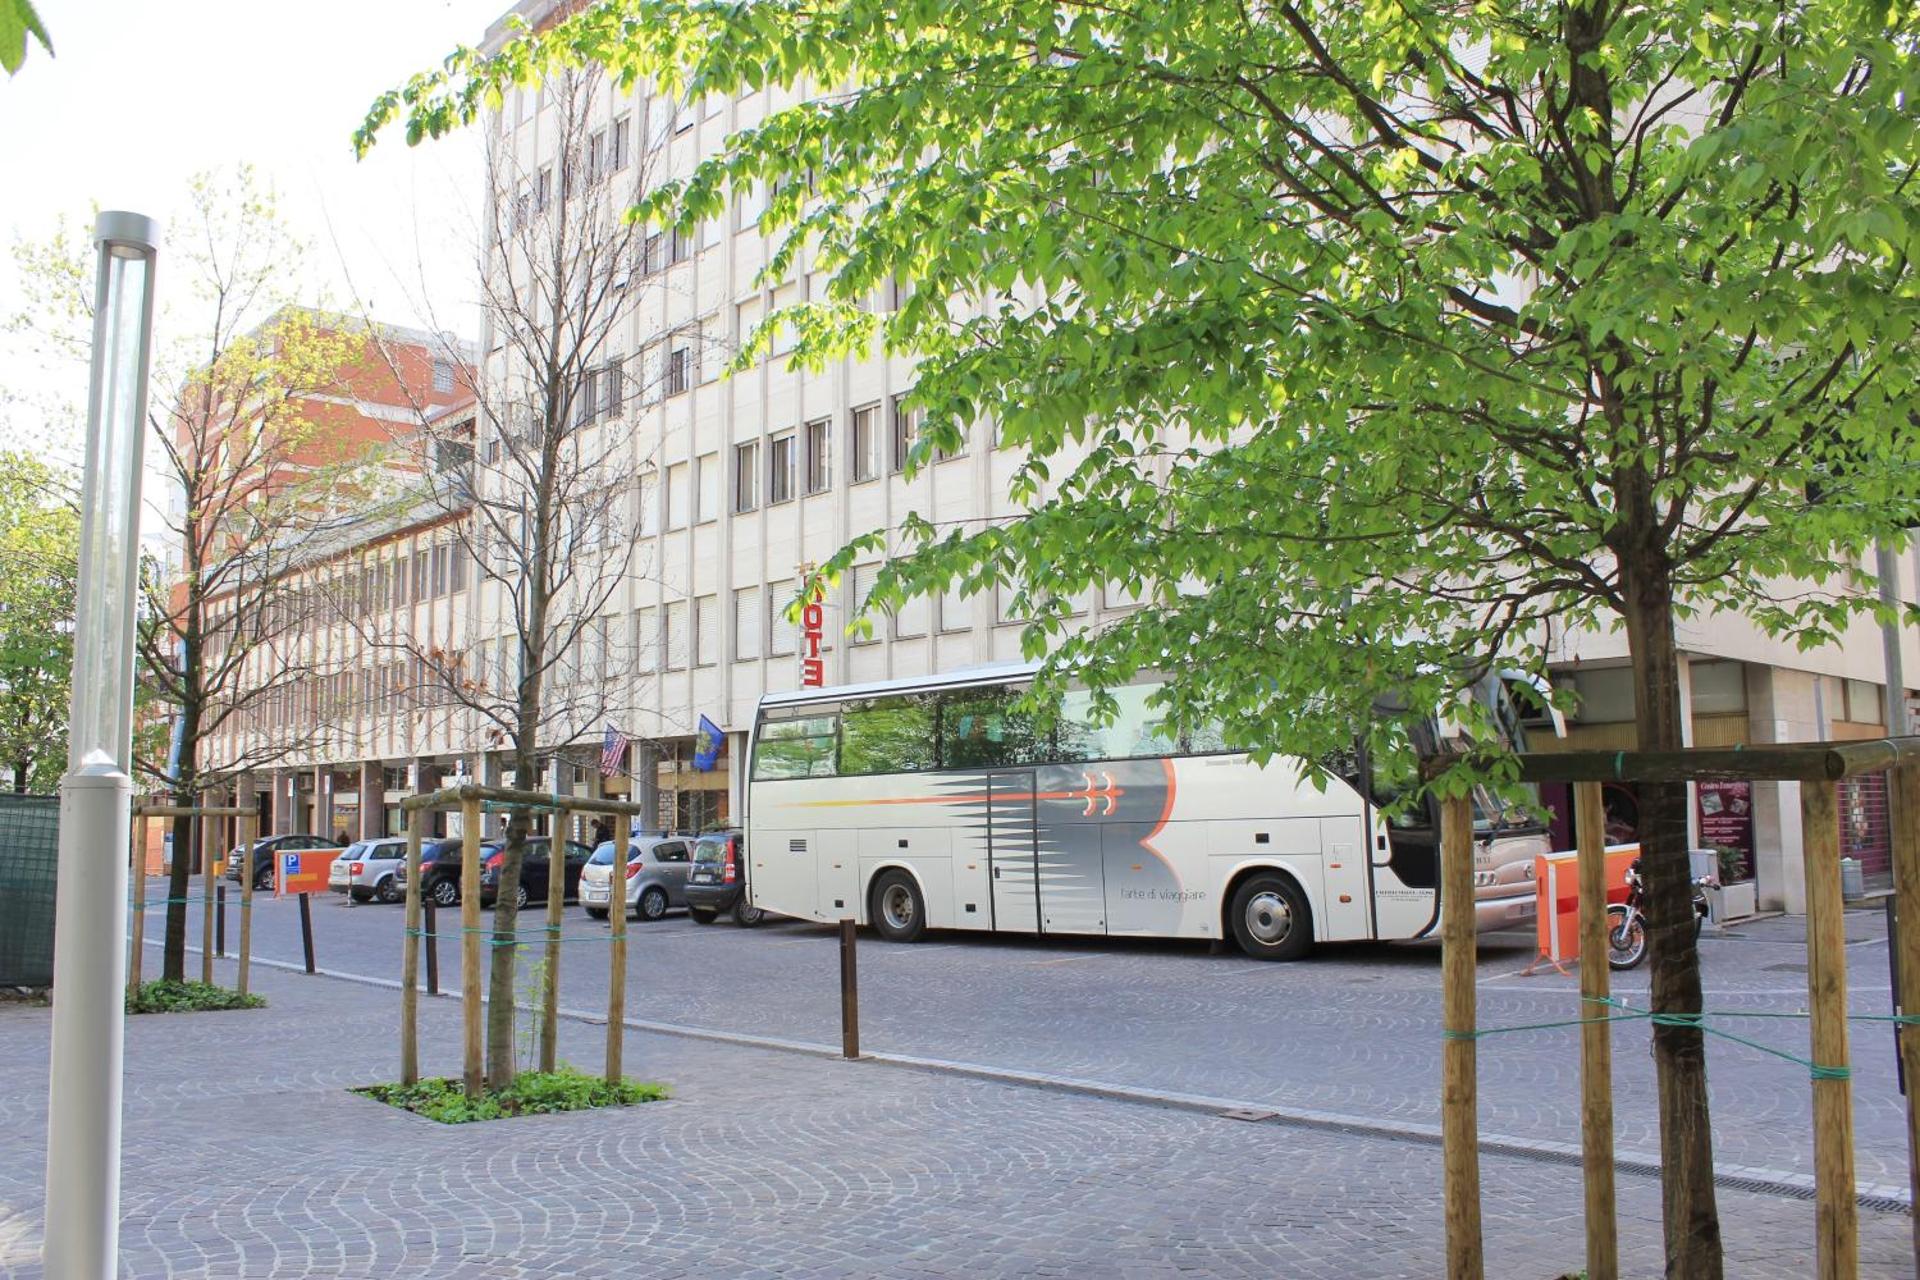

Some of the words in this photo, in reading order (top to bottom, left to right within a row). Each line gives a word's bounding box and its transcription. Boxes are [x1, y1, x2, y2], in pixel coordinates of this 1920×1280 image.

[288, 854, 297, 866] P
[1148, 888, 1157, 899] di
[1159, 888, 1207, 904] viaggiare
